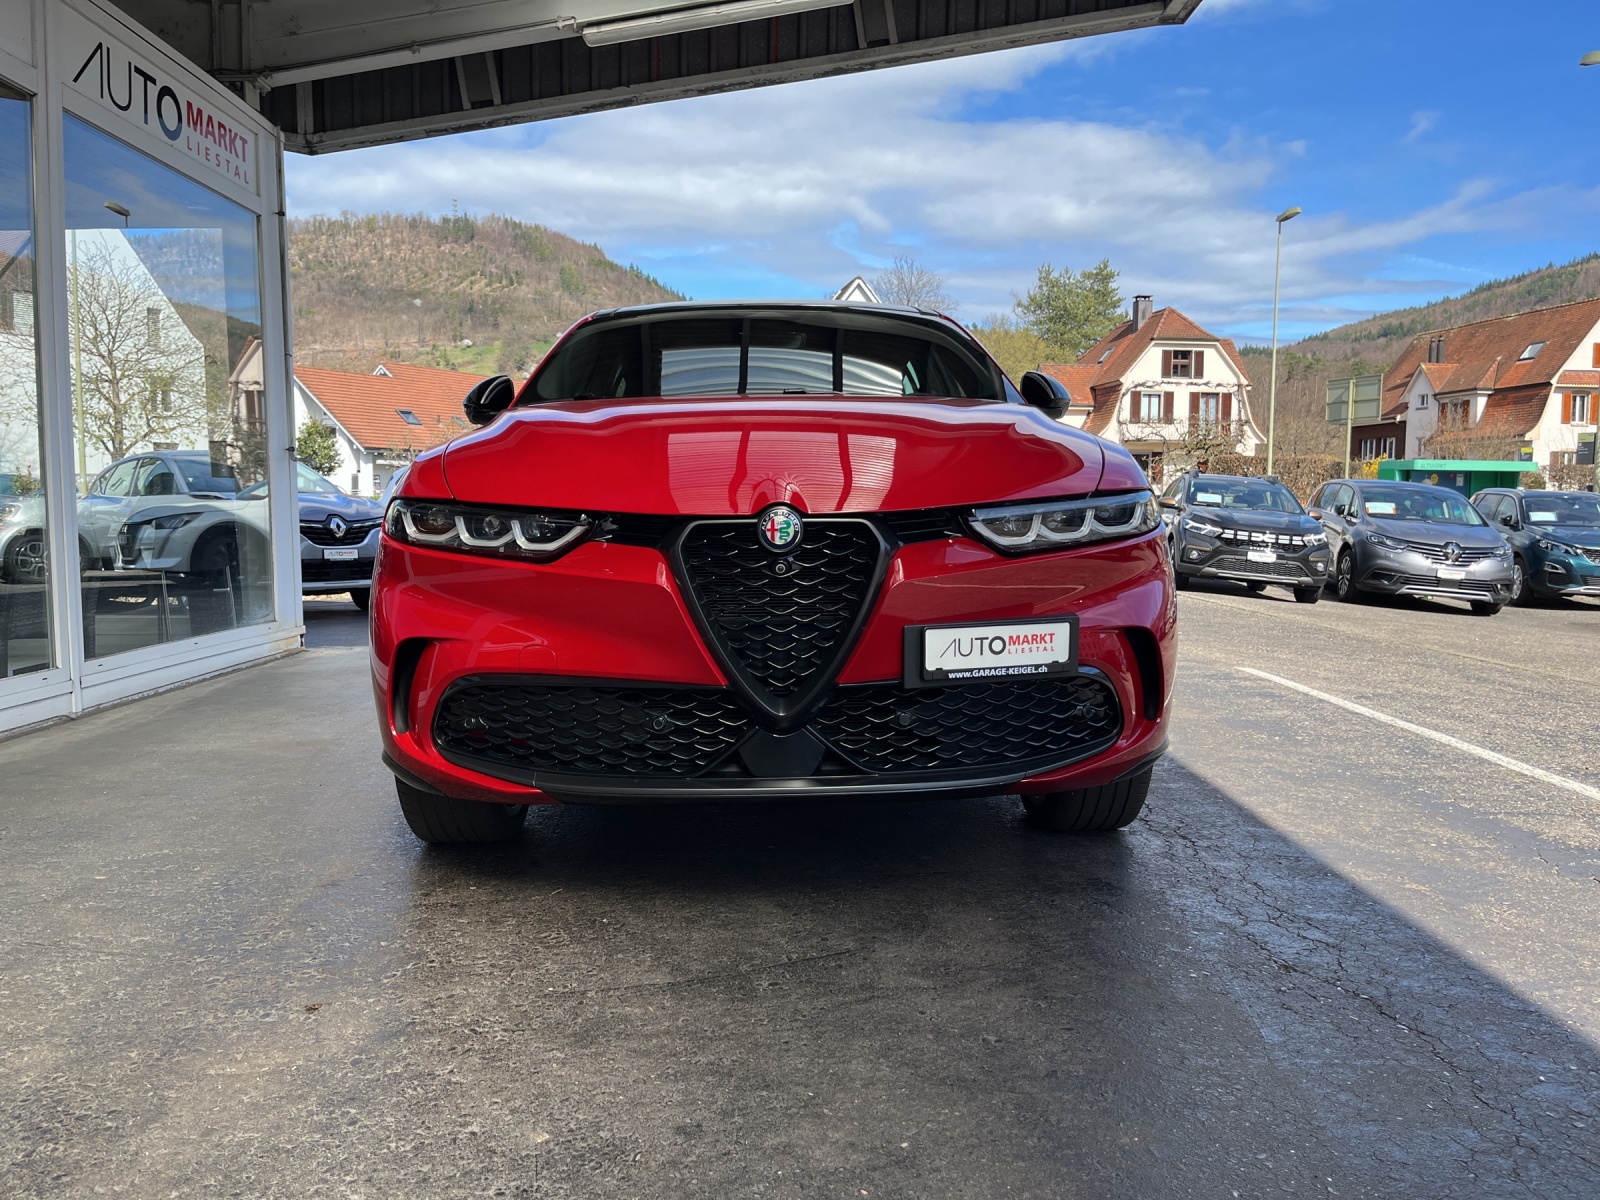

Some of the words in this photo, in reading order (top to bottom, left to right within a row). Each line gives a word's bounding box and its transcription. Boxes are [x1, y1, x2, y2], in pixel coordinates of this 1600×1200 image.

[72, 42, 182, 141] AUTO
[186, 100, 248, 163] MARKT
[186, 135, 249, 185] LIESTAL
[940, 635, 1007, 658] AUTO
[1008, 633, 1055, 646] MARKT
[1008, 646, 1055, 654] LIESTAL
[948, 665, 1048, 679] www.GARAGE-KEIGEL.ch
